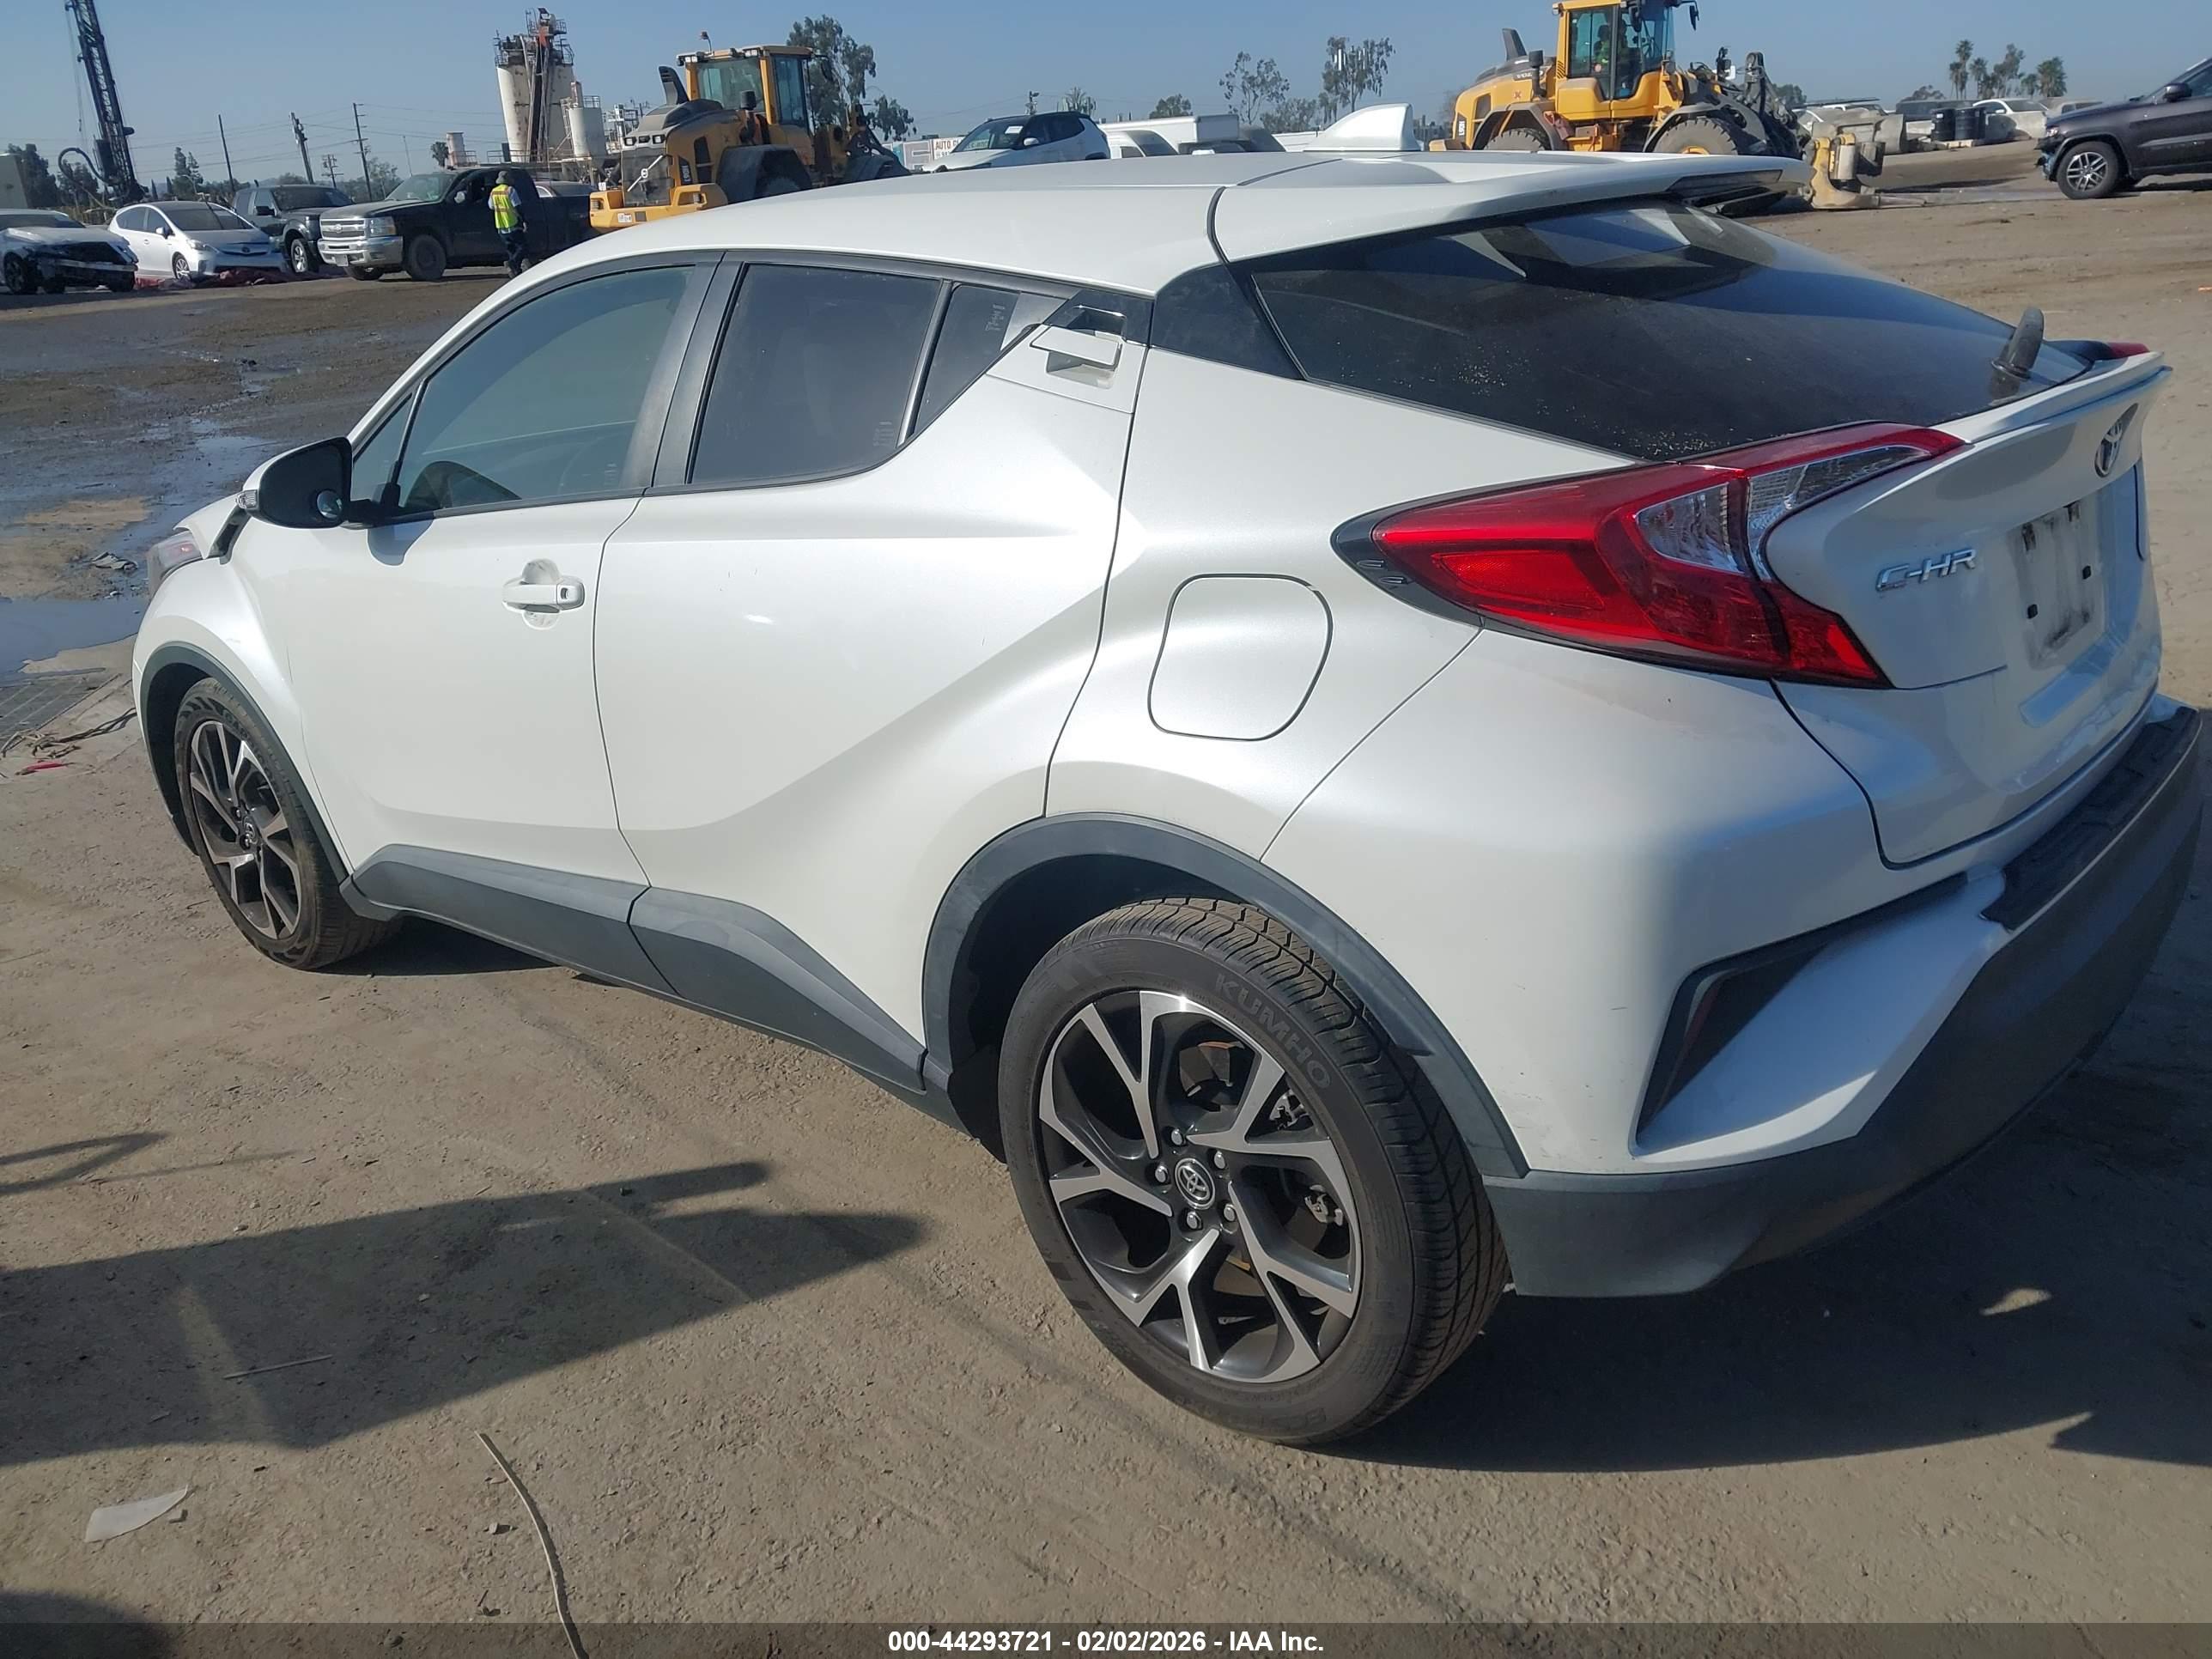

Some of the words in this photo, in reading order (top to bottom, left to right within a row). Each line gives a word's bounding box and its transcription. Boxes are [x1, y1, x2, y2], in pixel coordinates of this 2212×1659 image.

[936, 140, 951, 150] AUTO
[1876, 548, 1976, 591] C-HR
[1216, 974, 1330, 1088] KUMHO
